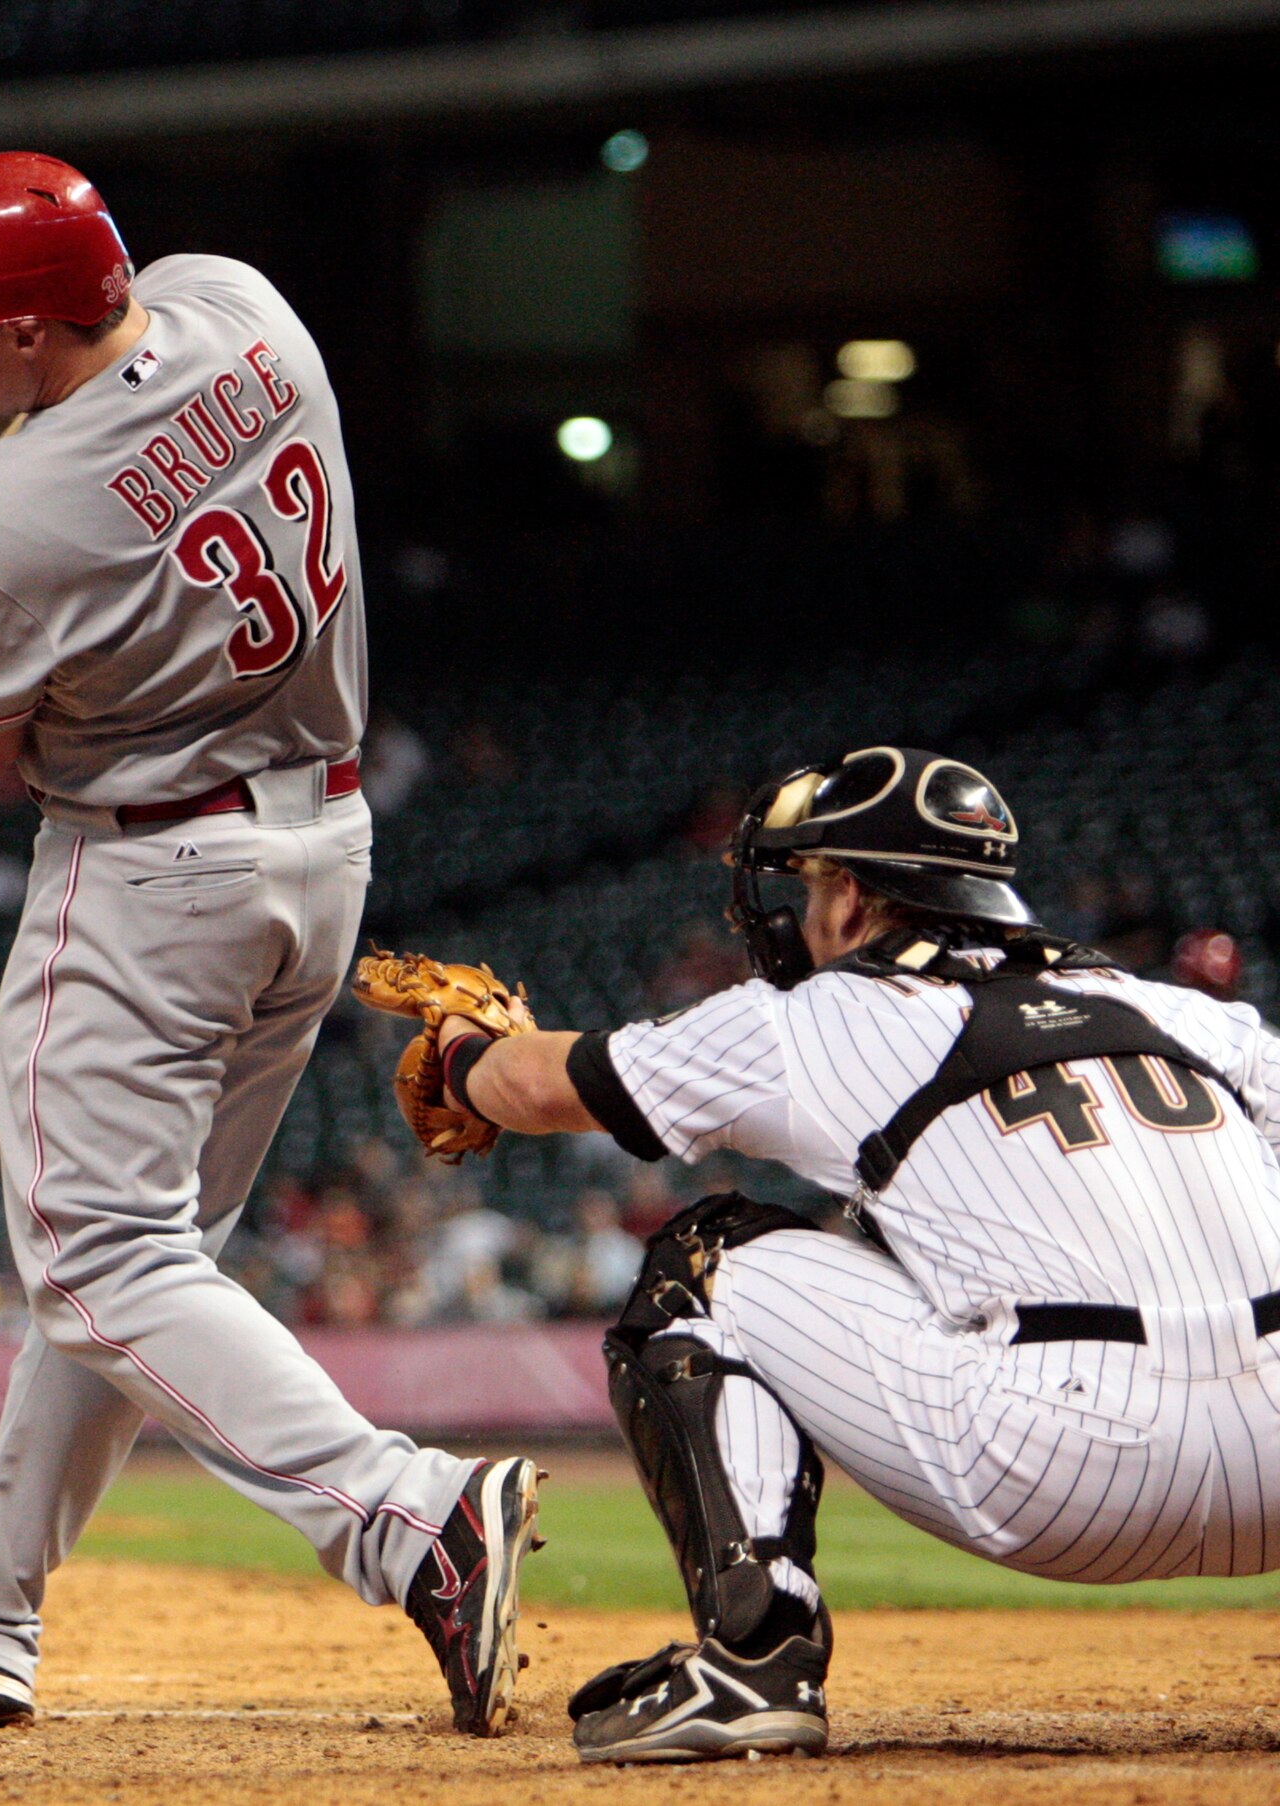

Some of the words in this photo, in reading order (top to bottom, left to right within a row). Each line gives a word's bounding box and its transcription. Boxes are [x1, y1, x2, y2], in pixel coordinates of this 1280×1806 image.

[101, 263, 128, 303] 32
[106, 338, 299, 540] BRUCE
[169, 437, 348, 680] 32
[974, 1022, 1226, 1154] 40
